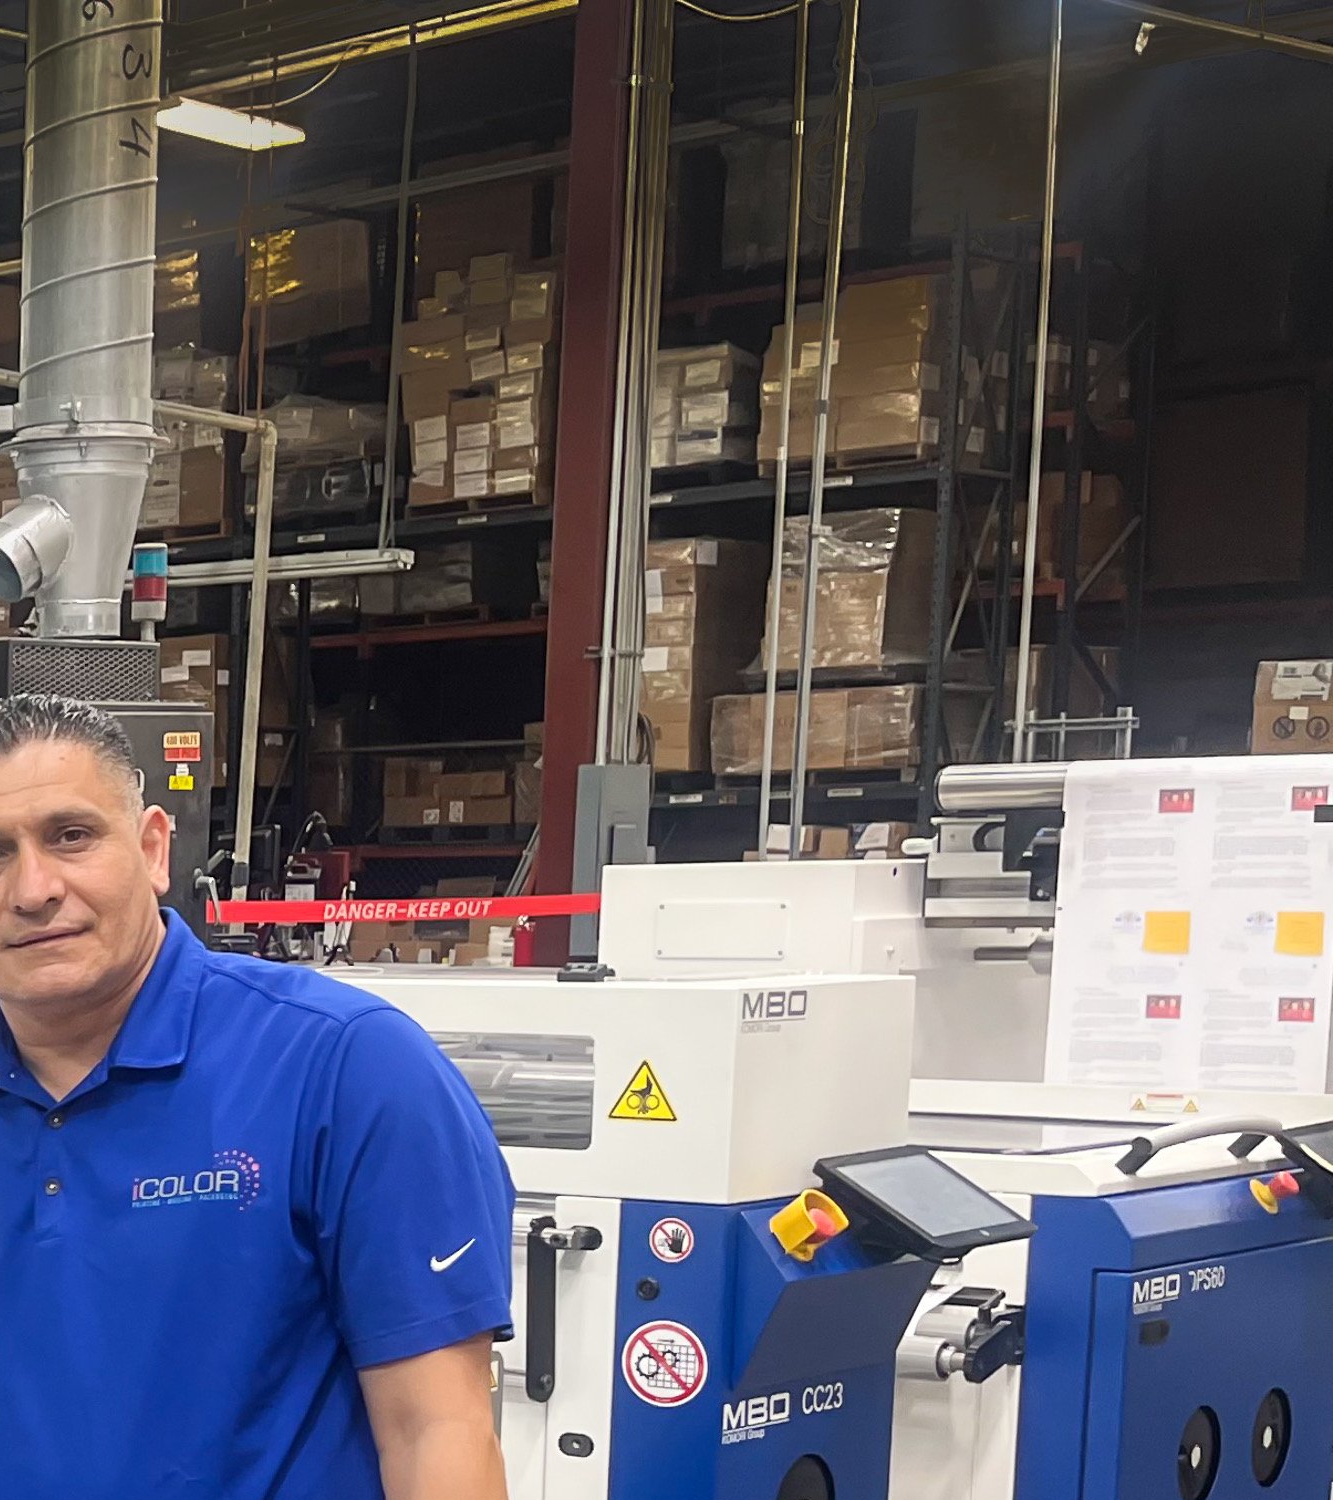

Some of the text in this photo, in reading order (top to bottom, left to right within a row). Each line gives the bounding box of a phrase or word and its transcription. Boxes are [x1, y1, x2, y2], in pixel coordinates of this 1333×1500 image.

[323, 900, 493, 920] DANGER-KEEP OUT
[742, 990, 808, 1019] MBO
[133, 1170, 240, 1201] iCOLOR
[1133, 1273, 1181, 1304] MBO
[721, 1382, 844, 1431] MBO CC23
